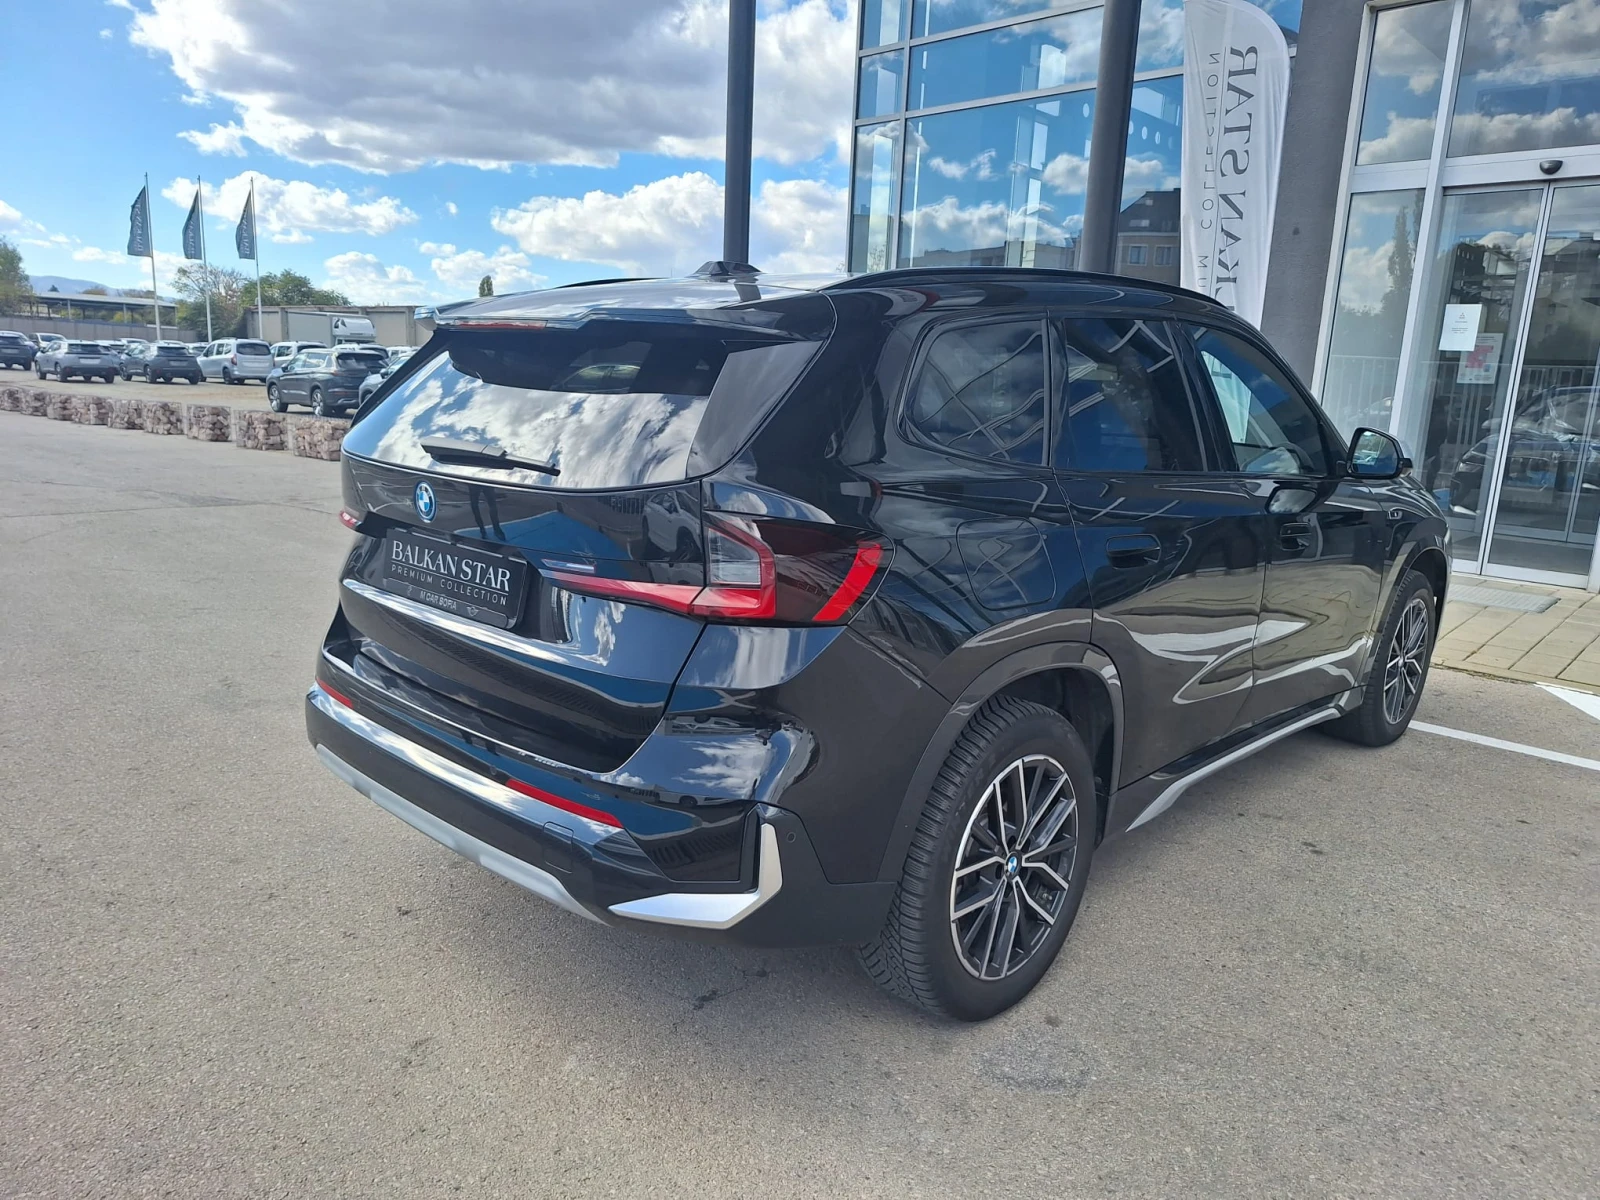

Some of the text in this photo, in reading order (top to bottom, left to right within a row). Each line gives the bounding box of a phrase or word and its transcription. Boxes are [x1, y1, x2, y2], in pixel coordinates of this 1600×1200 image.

[391, 540, 511, 592] BALKAN STAR
[391, 564, 507, 606] PREMIUM COLLECTION
